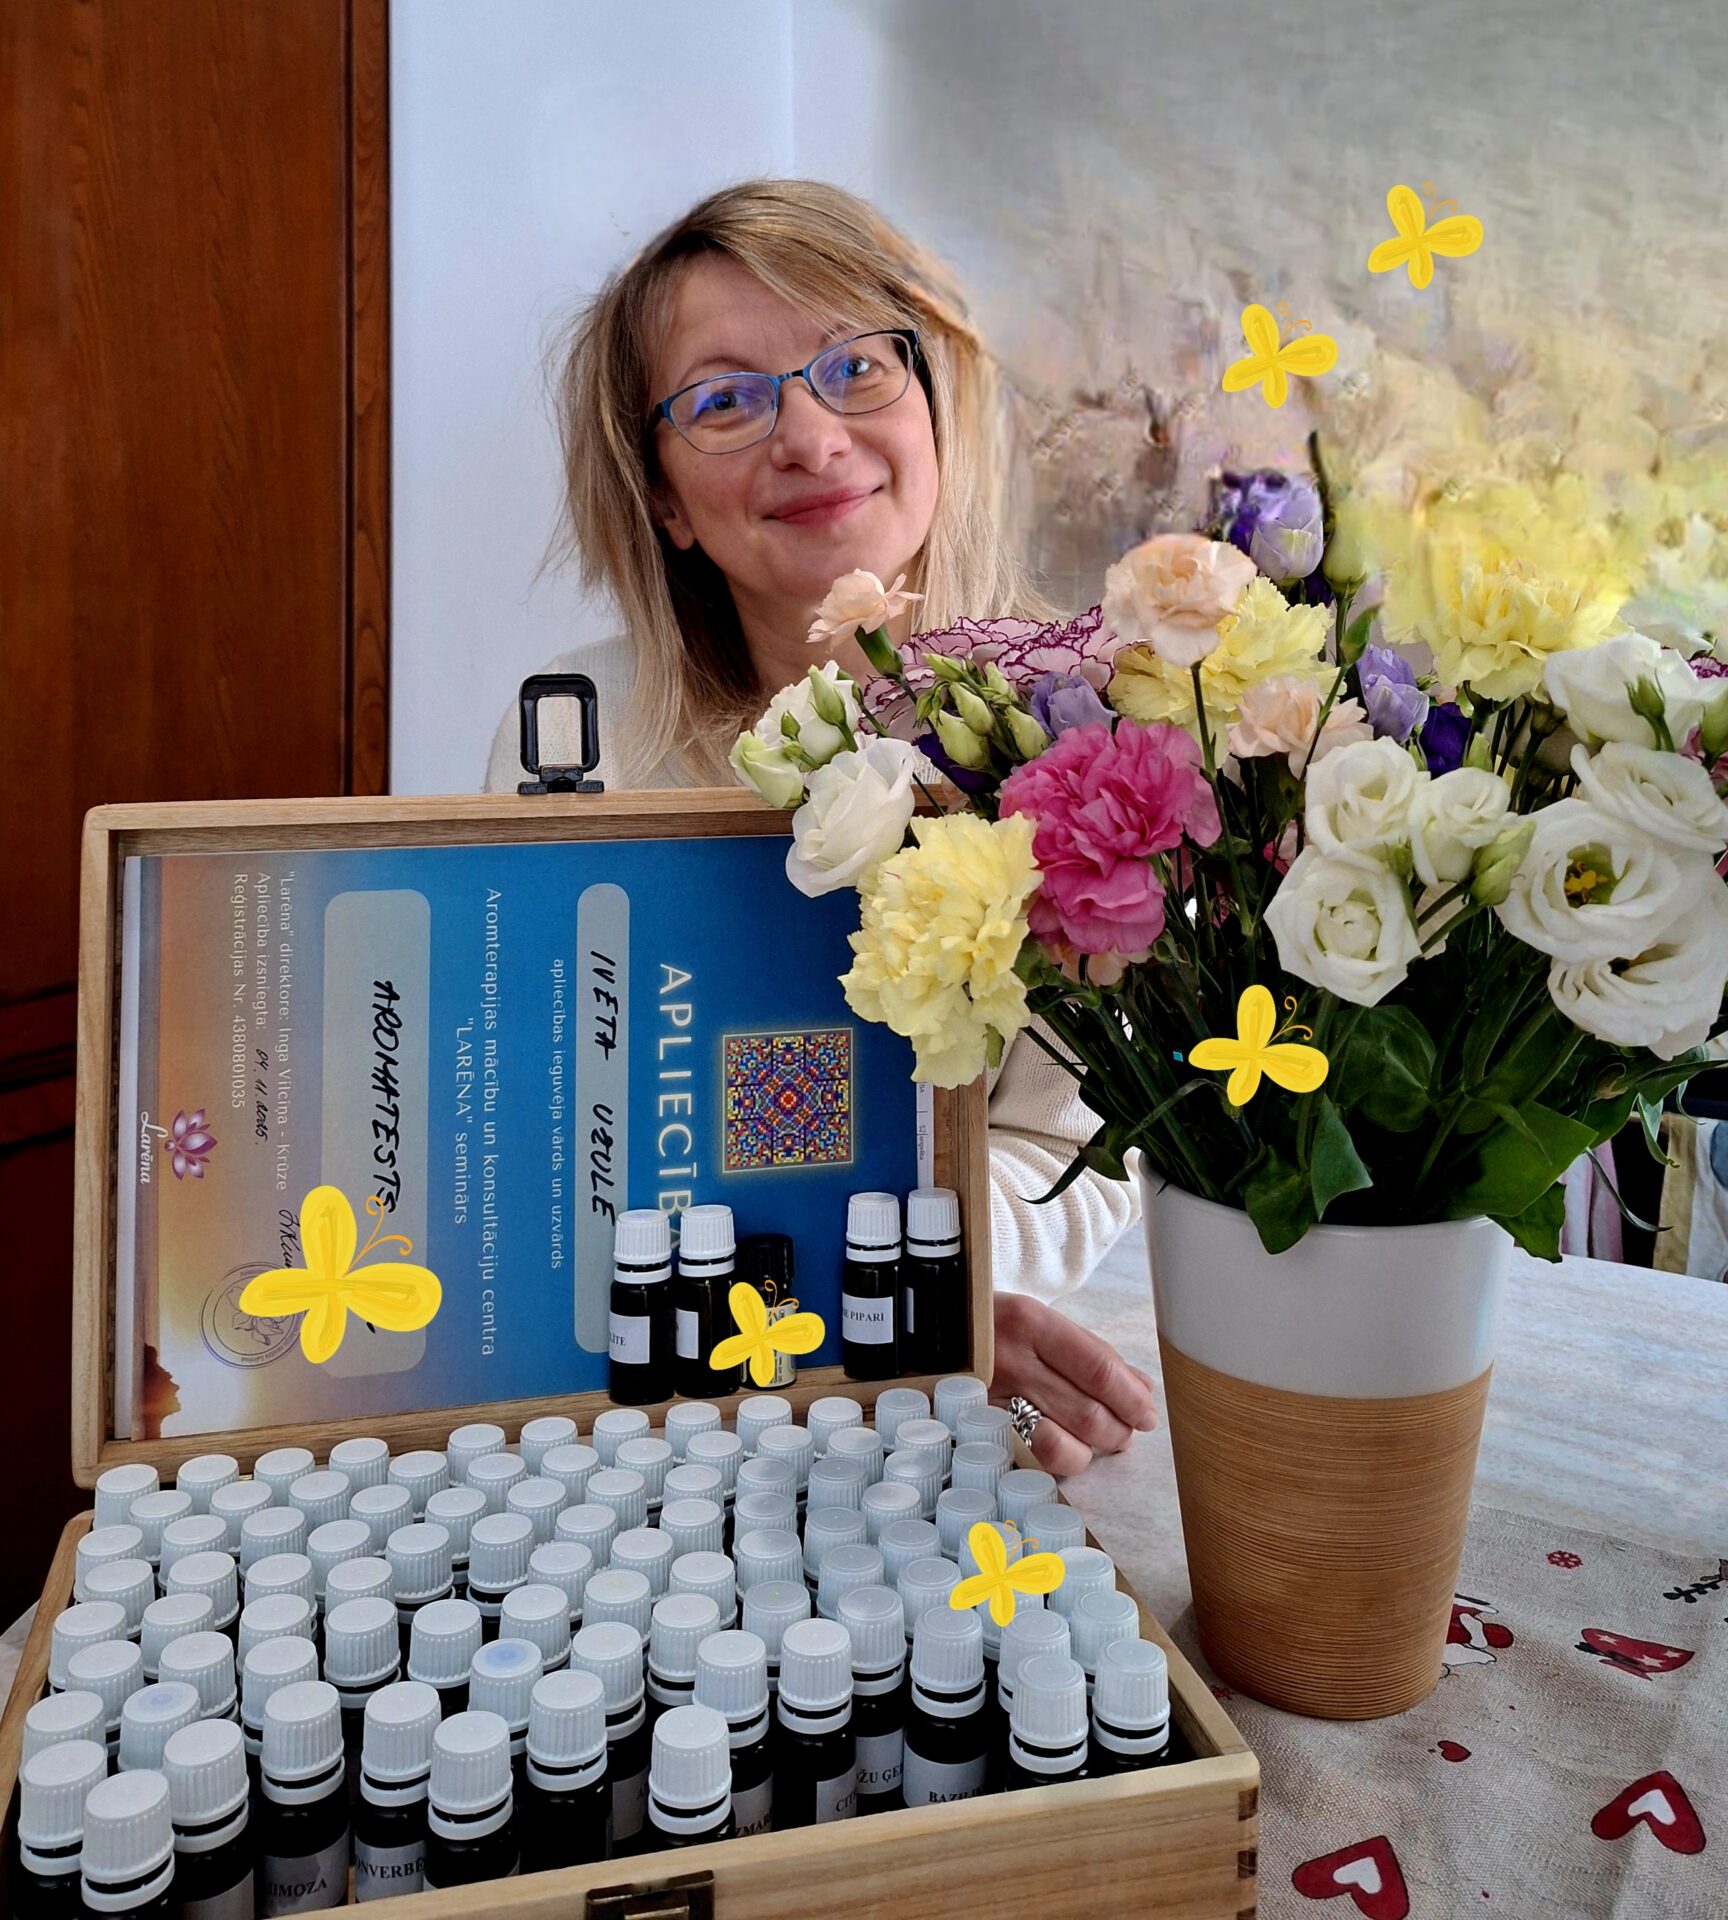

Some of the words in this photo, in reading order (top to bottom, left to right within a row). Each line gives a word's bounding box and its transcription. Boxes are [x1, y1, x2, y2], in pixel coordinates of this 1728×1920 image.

[230, 875, 248, 976] Reģistrācijas
[254, 873, 271, 946] Apliecība
[281, 871, 295, 936] "Larēna"
[253, 955, 270, 1029] izsniegta:
[279, 944, 293, 1020] direktore:
[481, 889, 501, 1030] Aromterapijas
[233, 984, 246, 1007] Nr.
[550, 959, 566, 1042] apliecības
[591, 951, 618, 1060] IVETA
[232, 1016, 246, 1108] 4380801035
[275, 1028, 292, 1061] Inga
[456, 1018, 474, 1122] "LARĒNA"
[484, 1040, 499, 1111] mācību
[275, 1069, 291, 1124] Vilciņa
[371, 981, 402, 1213] AROMATESTS
[549, 1051, 564, 1119] ieguvēja
[139, 1112, 168, 1184] Larēna
[277, 1144, 290, 1189] Krūze
[484, 1122, 495, 1144] un
[552, 1127, 565, 1170] vārds
[455, 1133, 471, 1223] seminārs
[552, 1179, 561, 1197] un
[478, 1155, 499, 1279] konsultāciju
[552, 1205, 564, 1268] uzvārds
[482, 1290, 496, 1354] centra
[850, 1311, 884, 1322] PIPARI
